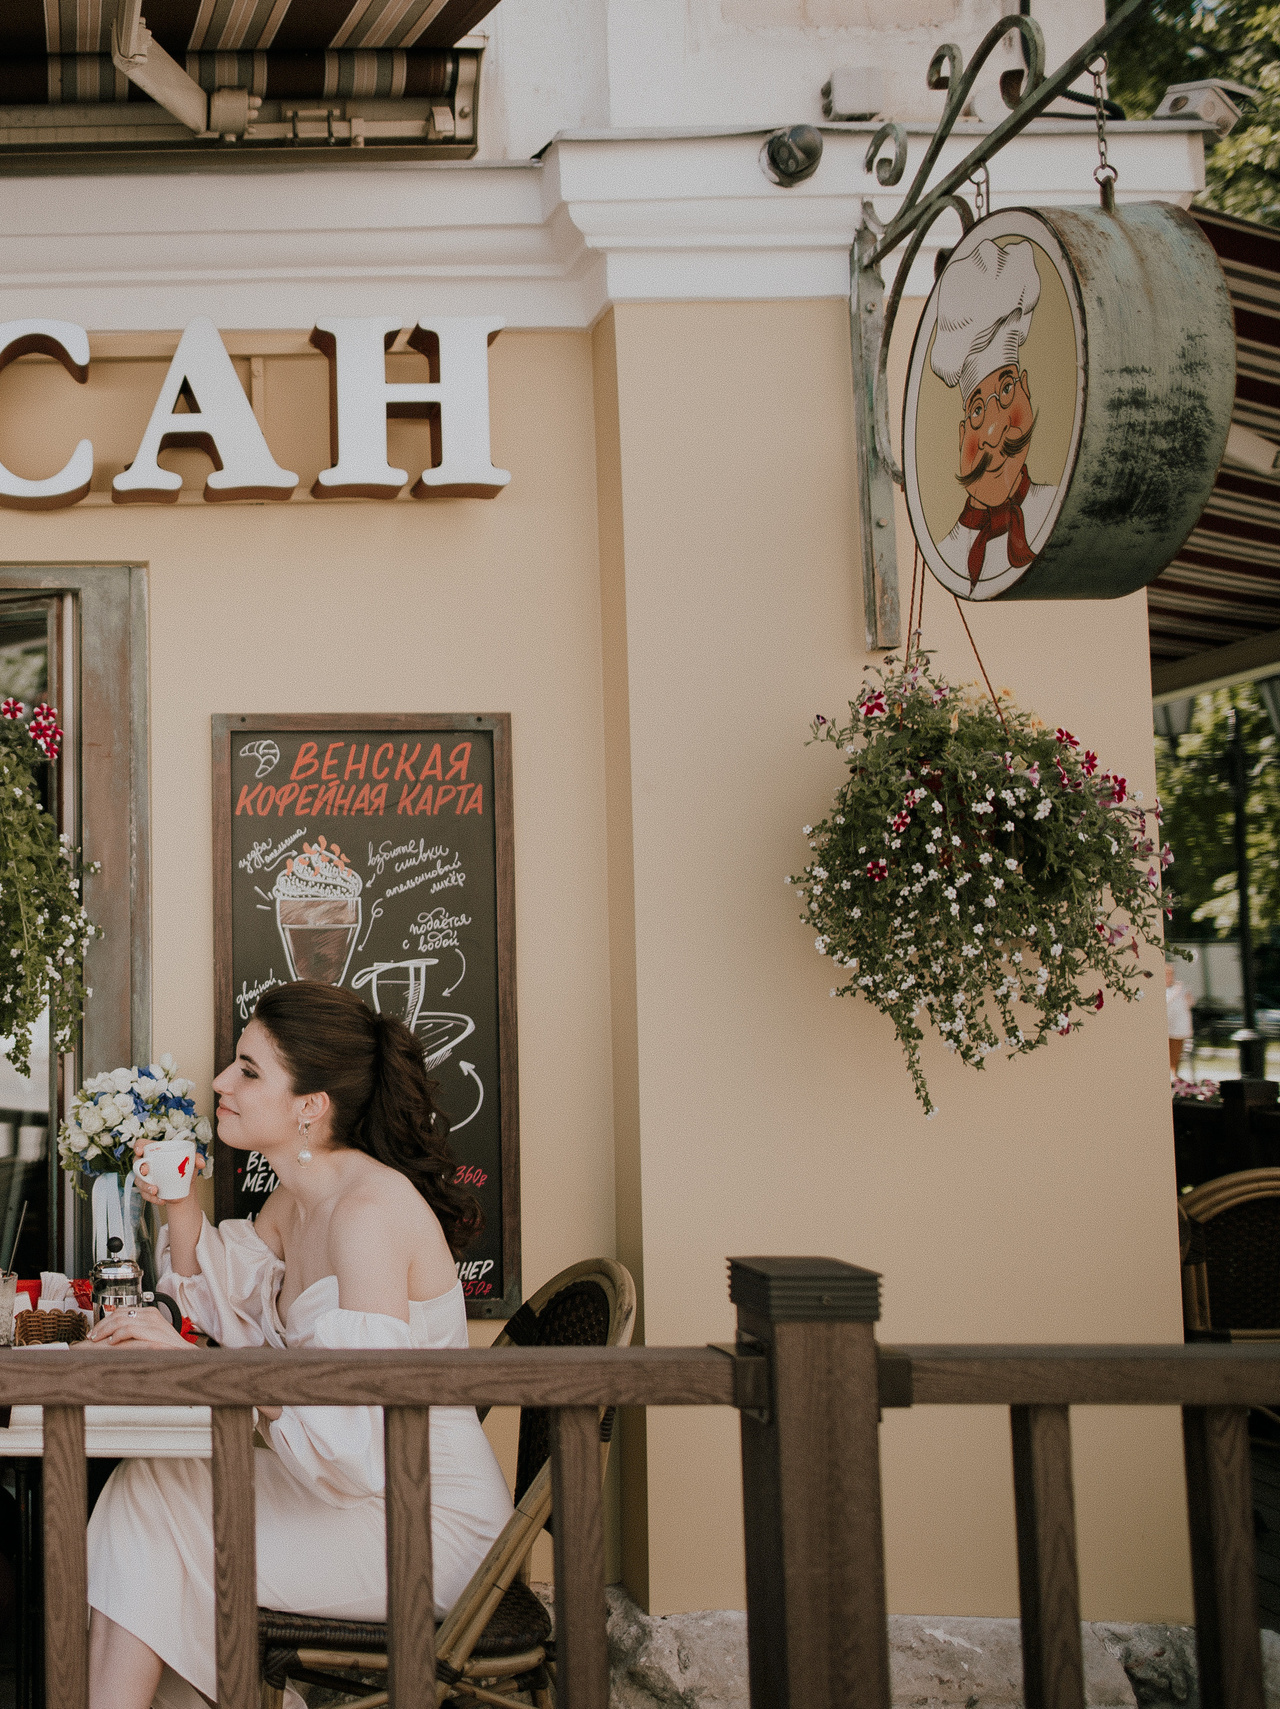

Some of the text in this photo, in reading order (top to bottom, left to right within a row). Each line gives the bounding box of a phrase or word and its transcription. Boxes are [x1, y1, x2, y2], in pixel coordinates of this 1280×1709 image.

[290, 742, 472, 781] ВЕНСКАЯ
[234, 779, 484, 817] КОФЕЙНАЯ КАРТА
[409, 907, 472, 936] подаётся
[402, 929, 460, 953] с водой
[246, 1150, 272, 1172] ВЕ
